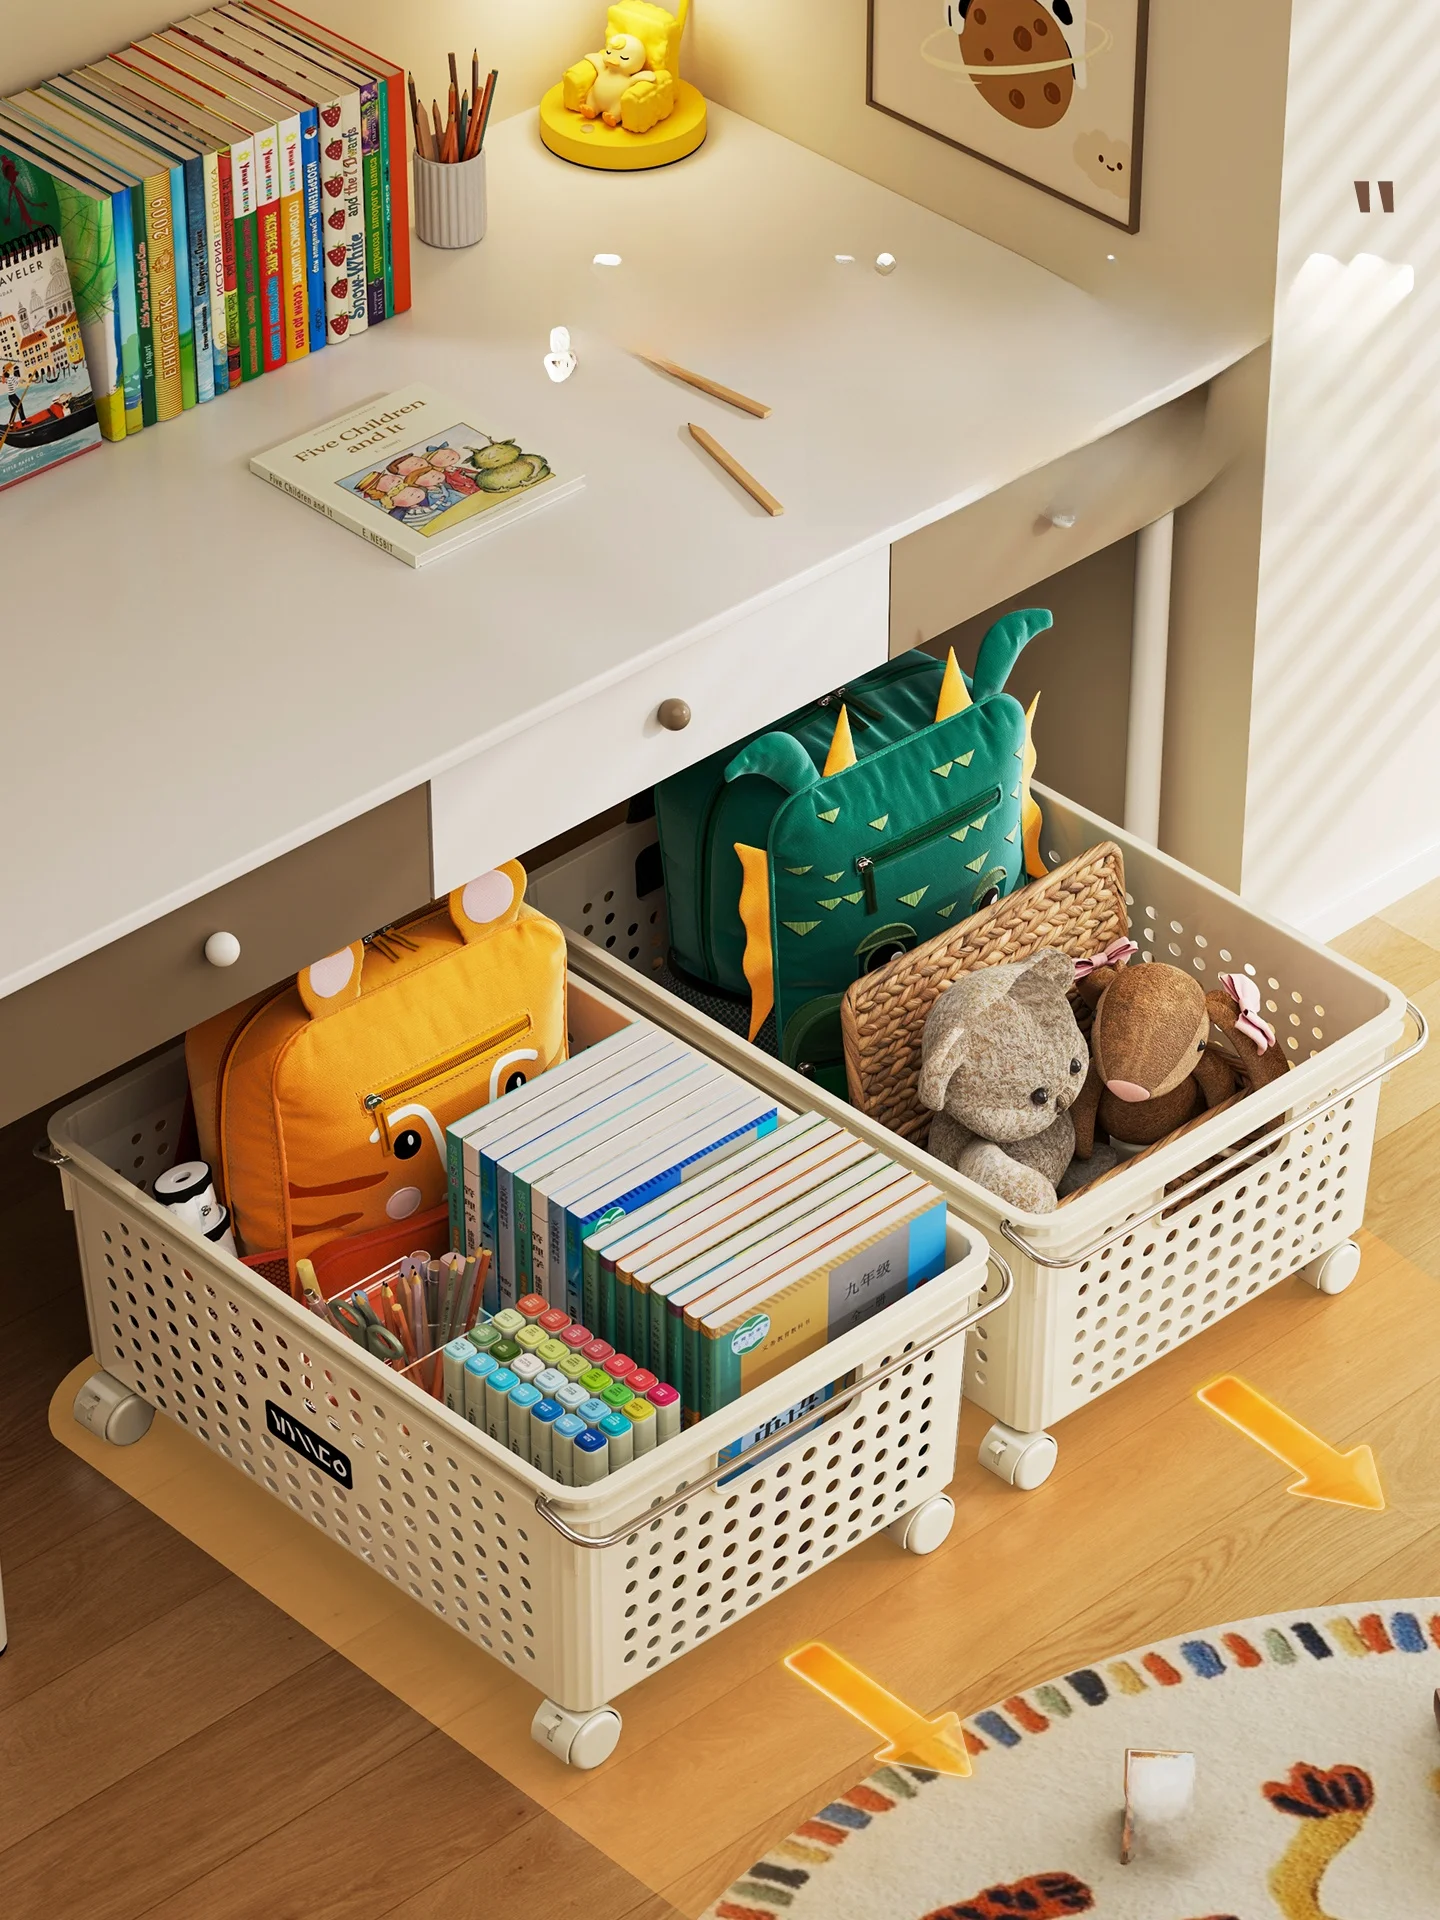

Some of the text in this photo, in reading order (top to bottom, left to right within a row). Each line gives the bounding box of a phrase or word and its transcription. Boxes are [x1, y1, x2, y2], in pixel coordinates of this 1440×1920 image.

[341, 127, 362, 168] Dwarfs
[222, 176, 232, 190] The
[346, 176, 358, 196] the
[212, 166, 222, 235] ГЕВЕЙЧИКА
[222, 191, 234, 216] Famous
[347, 195, 359, 218] and
[369, 156, 384, 275] стрекоза второго шанса
[151, 198, 172, 240] 2009
[224, 217, 234, 254] Adventures
[214, 239, 225, 297] ИСТОРИЯ
[226, 262, 236, 276] Jack
[346, 232, 368, 320] Snow-White
[293, 292, 304, 317] осени
[155, 282, 177, 380] ЕНИСЕЙКА
[294, 318, 304, 329] до
[294, 330, 305, 350] лета
[293, 441, 340, 463] Five
[339, 400, 427, 441] Children
[346, 431, 388, 454] and
[384, 424, 406, 435] It
[269, 473, 333, 518] Five Children and It
[362, 528, 394, 553] E. NESBIT
[844, 1259, 892, 1301] 九年级
[851, 1292, 887, 1324] 全一册
